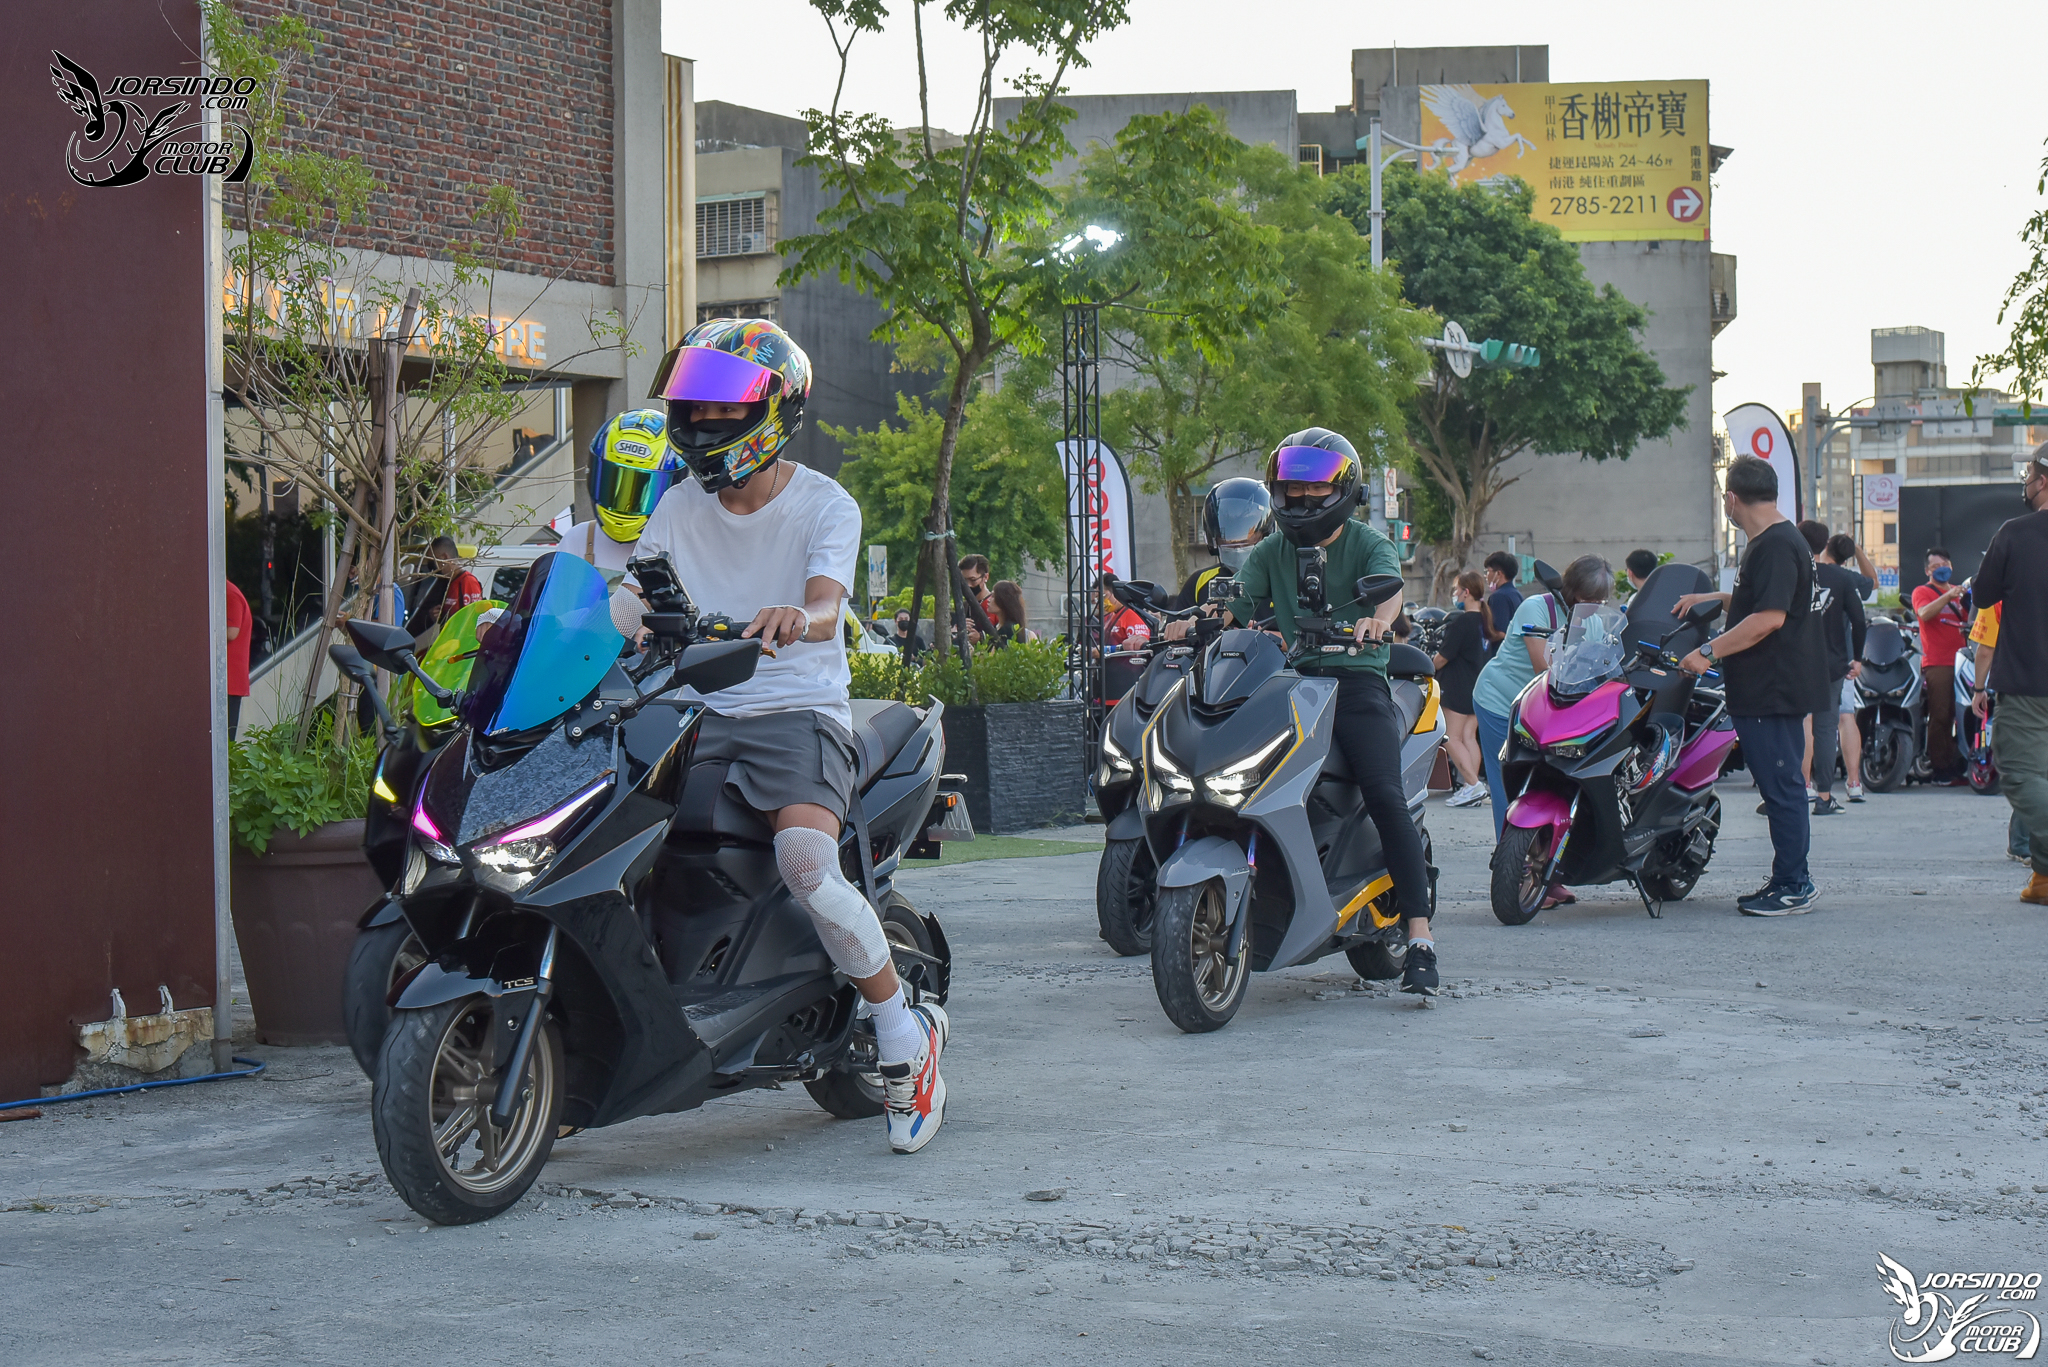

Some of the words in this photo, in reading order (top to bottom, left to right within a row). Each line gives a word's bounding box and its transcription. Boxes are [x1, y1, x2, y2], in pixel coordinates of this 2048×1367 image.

[1558, 89, 1688, 140] 香榭帝寶
[1690, 145, 1702, 182] 南港路
[1550, 176, 1574, 189] 南港
[1550, 195, 1657, 215] 2785-2211
[619, 442, 647, 456] SHOEI
[504, 976, 534, 989] TCS
